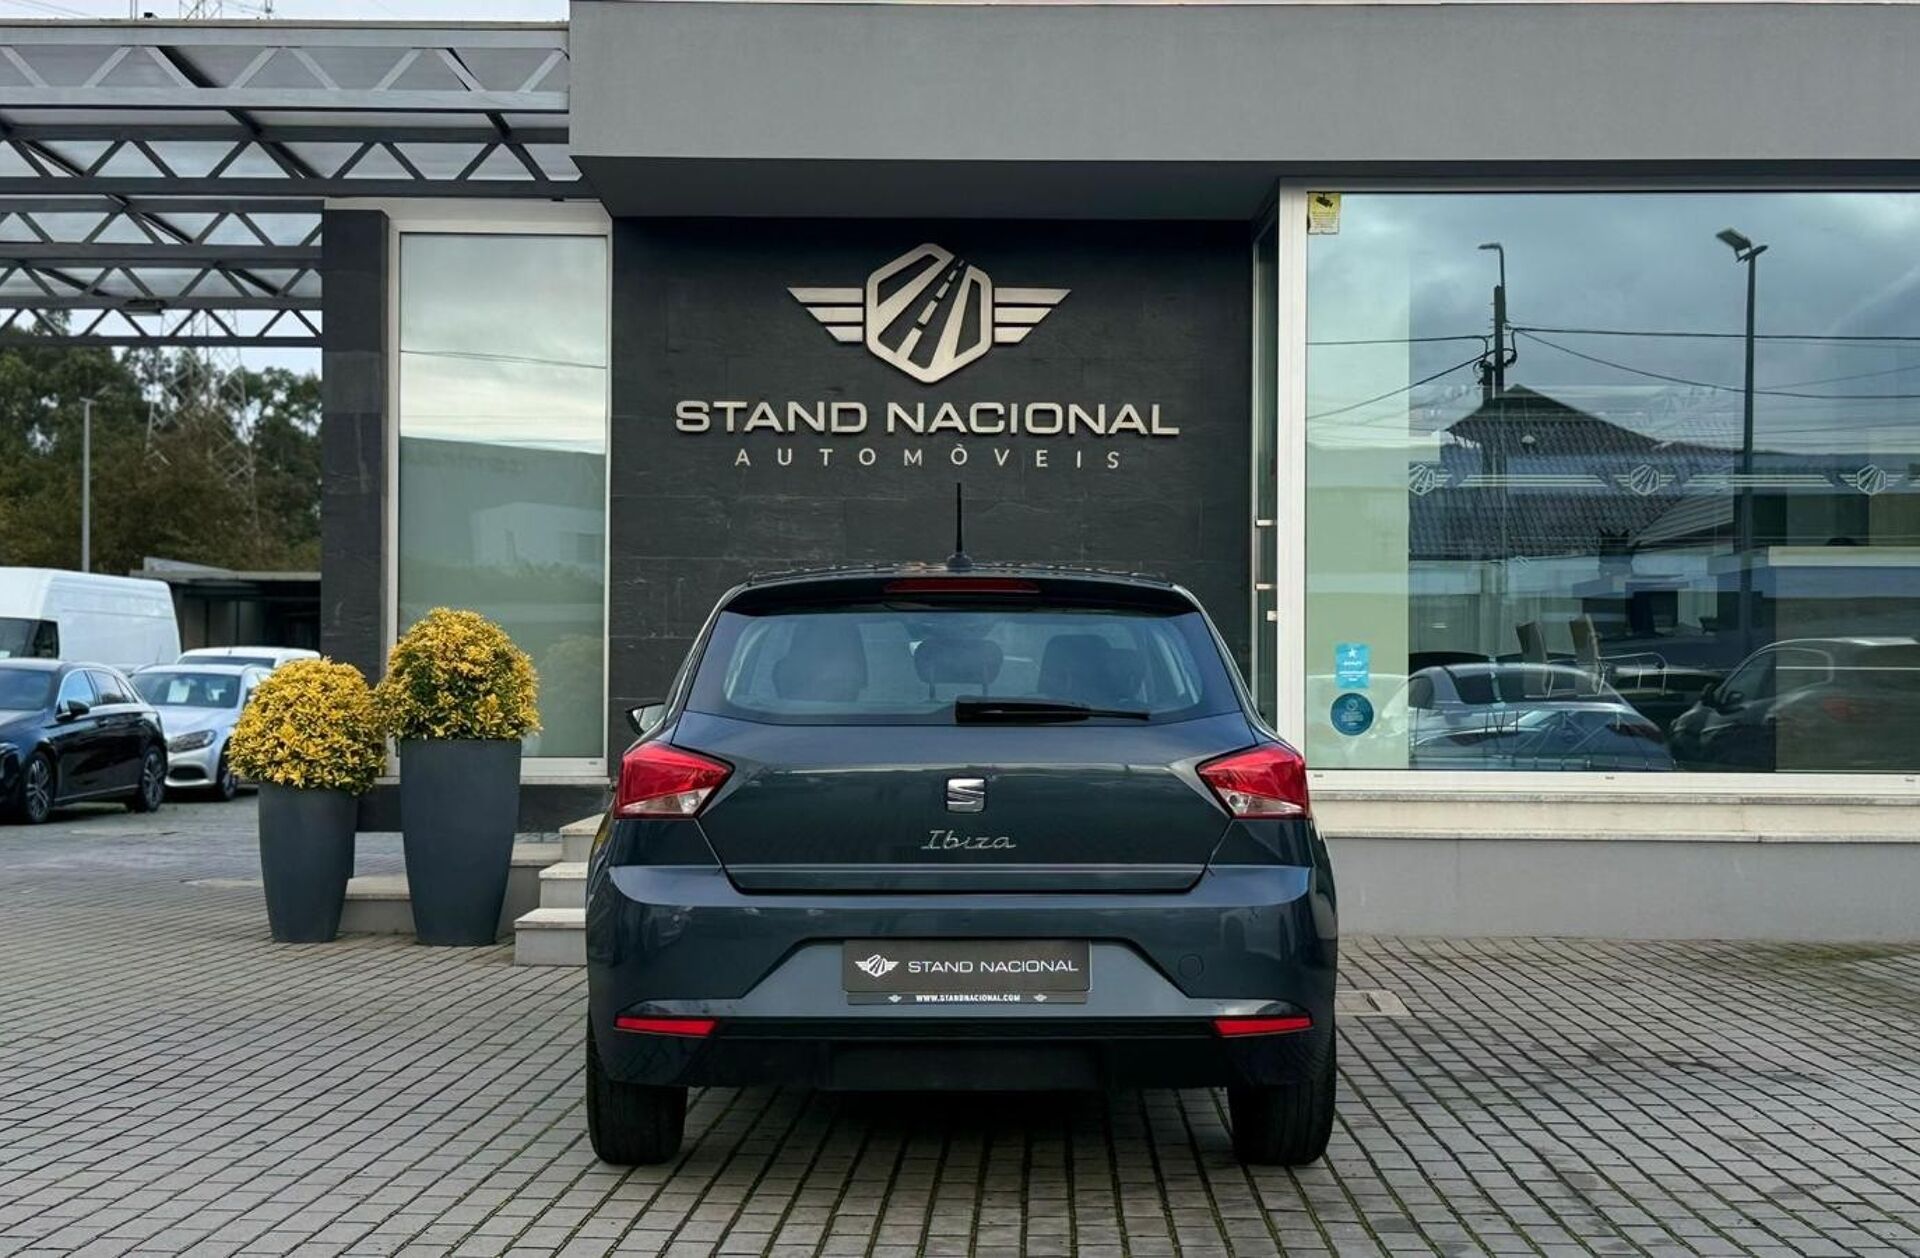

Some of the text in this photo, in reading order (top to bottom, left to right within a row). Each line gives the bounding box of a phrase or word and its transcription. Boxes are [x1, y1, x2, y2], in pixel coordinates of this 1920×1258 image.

[674, 400, 1181, 436] STAND NACIONAL
[921, 829, 1017, 850] Ibiza
[907, 960, 1079, 973] STAND NACIONAL
